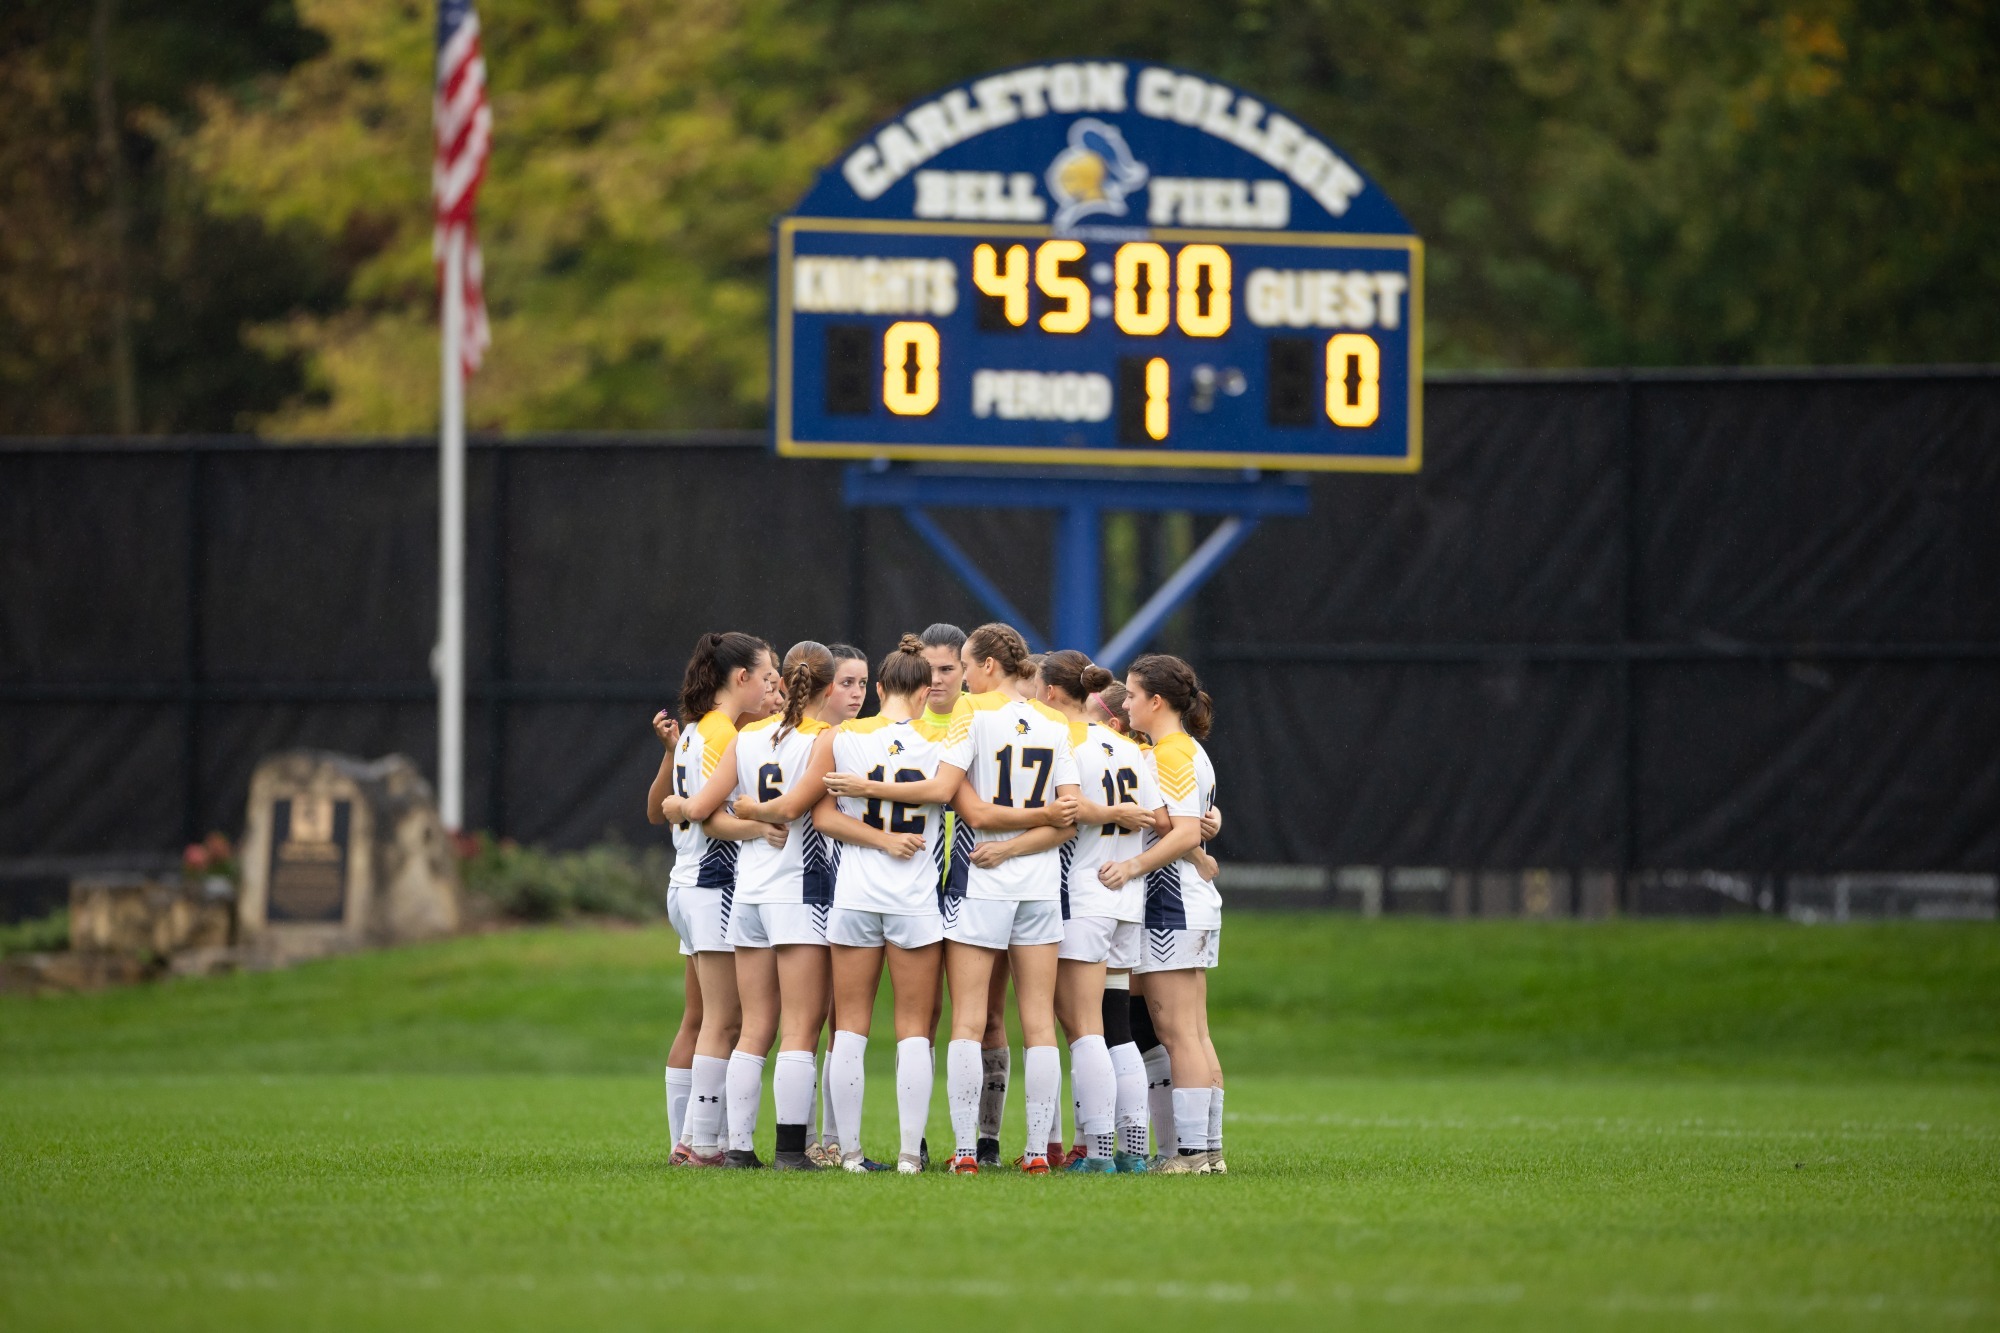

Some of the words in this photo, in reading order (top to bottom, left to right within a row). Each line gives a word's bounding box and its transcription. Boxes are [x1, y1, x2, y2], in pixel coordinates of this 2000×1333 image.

[843, 62, 1127, 200] CARLETON
[1137, 67, 1365, 217] COLLEGE
[914, 169, 1046, 220] BELL
[1148, 177, 1290, 228] FIELD
[794, 256, 957, 316] KNIGHTS
[973, 240, 1231, 337] 45:00
[1245, 267, 1406, 329] GUEST
[883, 321, 940, 416] 0
[972, 369, 1113, 422] PERIOD
[1145, 357, 1170, 440] 1
[1325, 333, 1380, 428] 0
[757, 761, 784, 804] 6
[863, 764, 927, 835] 12
[992, 743, 1055, 809] 17
[1100, 766, 1139, 836] 16
